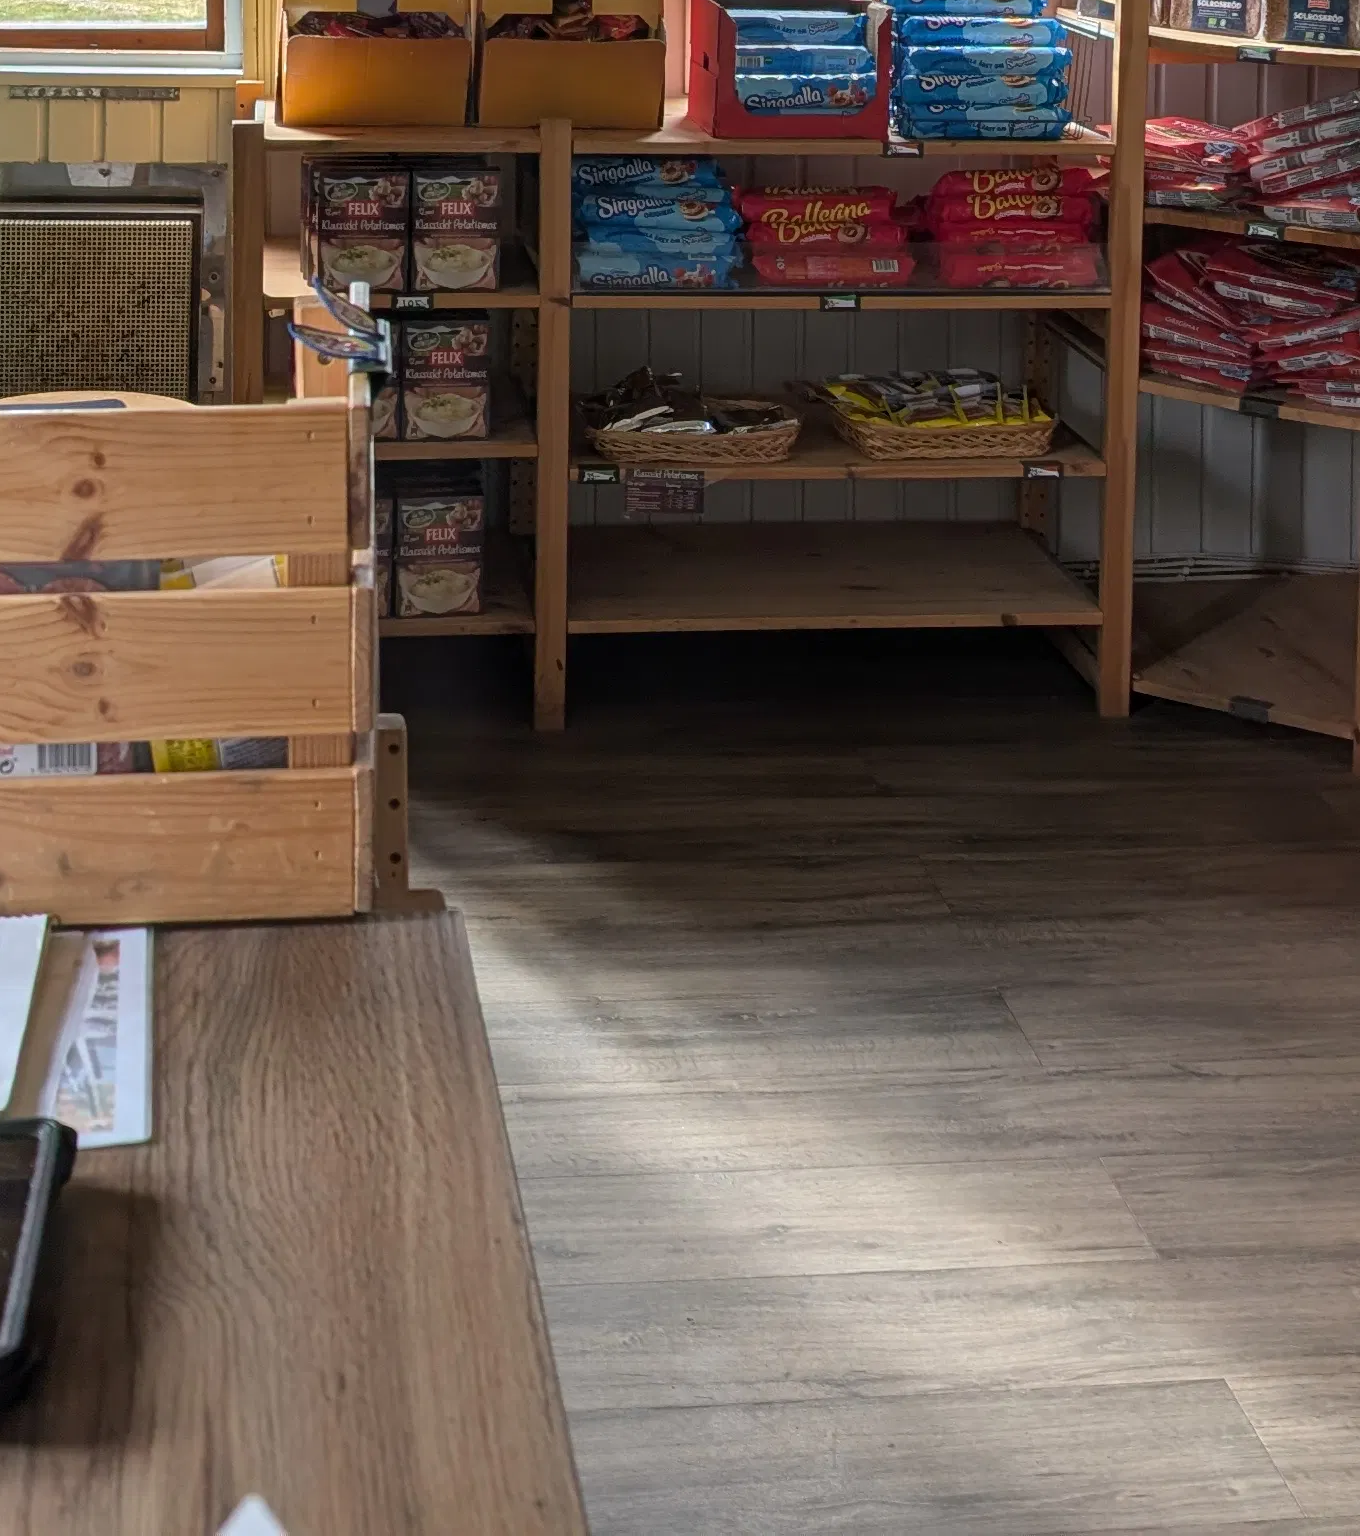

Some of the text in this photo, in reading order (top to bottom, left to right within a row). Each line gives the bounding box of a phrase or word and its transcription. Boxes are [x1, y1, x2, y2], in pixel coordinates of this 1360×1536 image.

[579, 158, 655, 184] Singoalla
[348, 202, 380, 216] FELIX
[441, 202, 473, 216] FELIX
[761, 200, 872, 228] Ballerina
[431, 352, 462, 365] FELIX
[426, 528, 457, 541] FELIX
